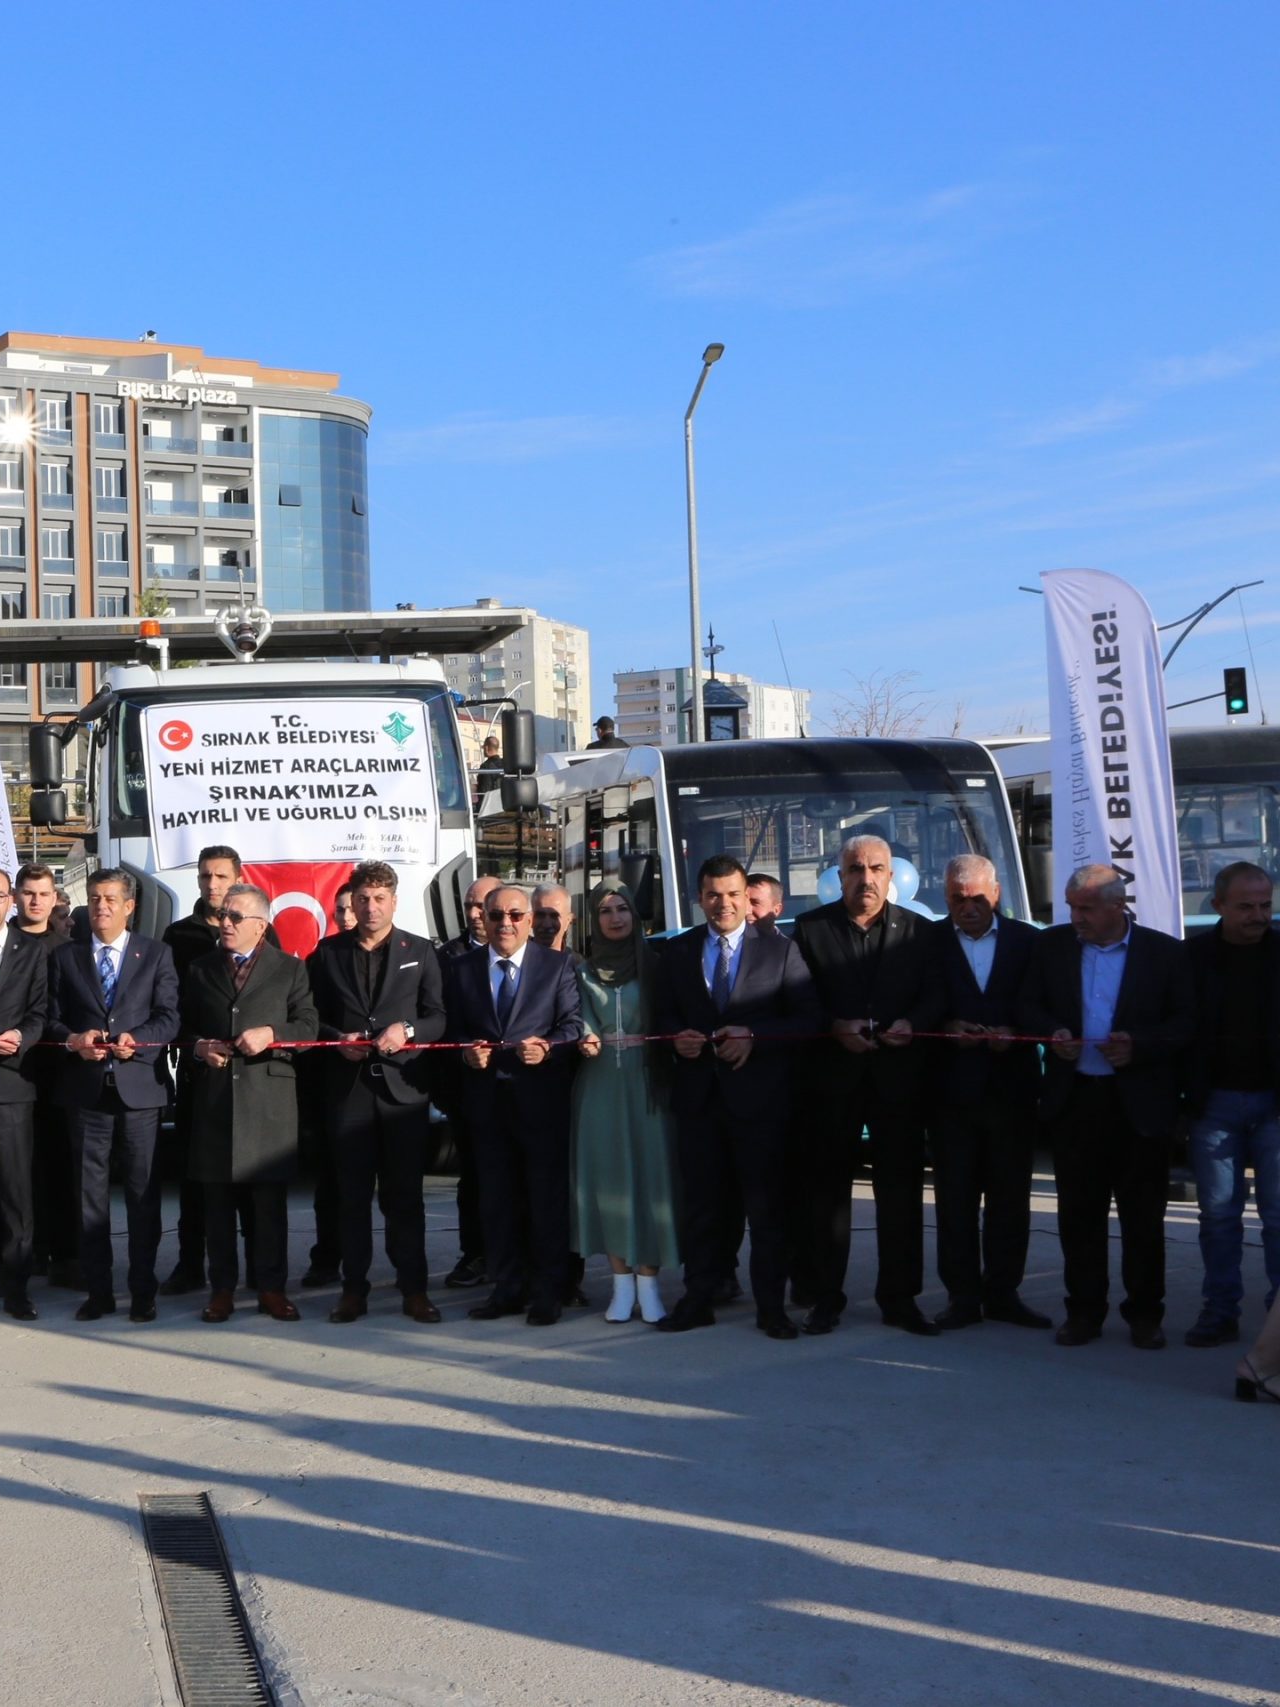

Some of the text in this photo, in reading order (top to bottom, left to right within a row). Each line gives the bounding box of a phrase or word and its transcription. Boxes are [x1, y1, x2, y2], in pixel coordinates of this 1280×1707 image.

[187, 387, 237, 405] plaza
[271, 714, 309, 728] T.C.
[159, 757, 421, 778] YENİ HİZMET ARAÇLARIMIZ
[162, 807, 238, 829] HAYIRLI
[245, 807, 271, 822] VE
[277, 804, 357, 821] UĞURLU
